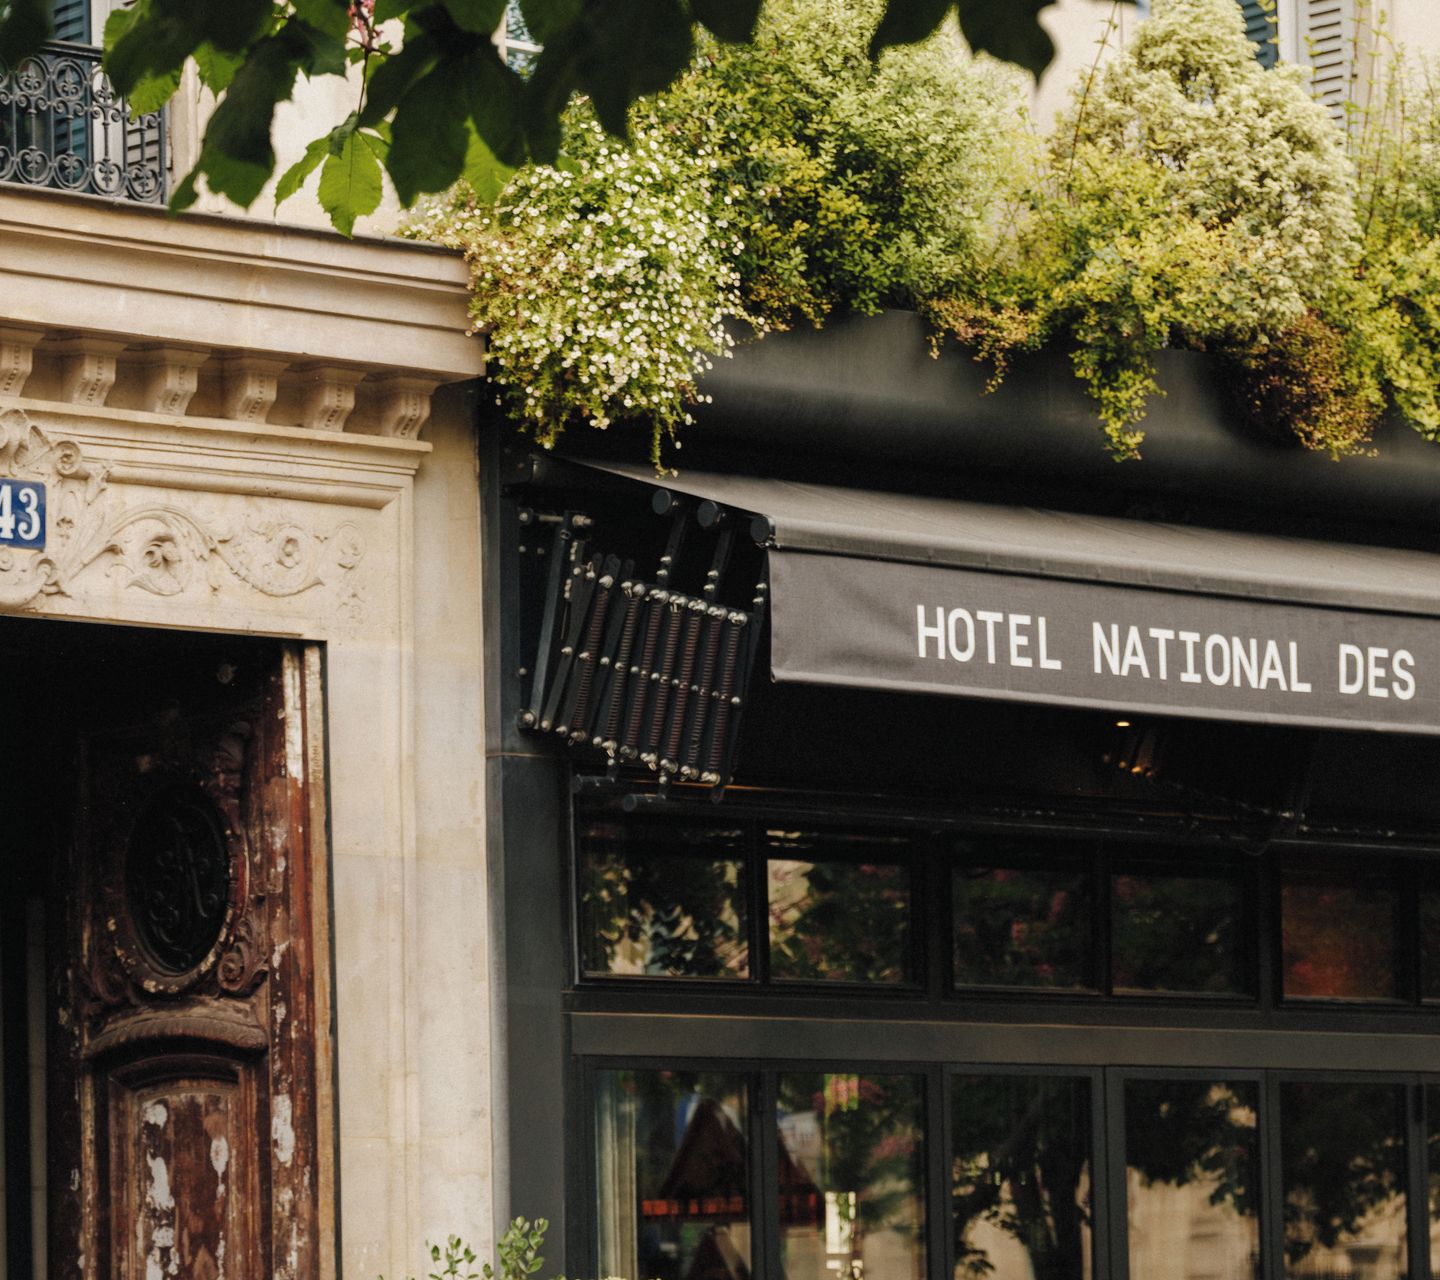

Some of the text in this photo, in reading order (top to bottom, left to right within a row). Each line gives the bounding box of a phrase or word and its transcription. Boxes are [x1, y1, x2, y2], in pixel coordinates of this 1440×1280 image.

[916, 604, 1416, 701] HOTEL NATIONAL DES
